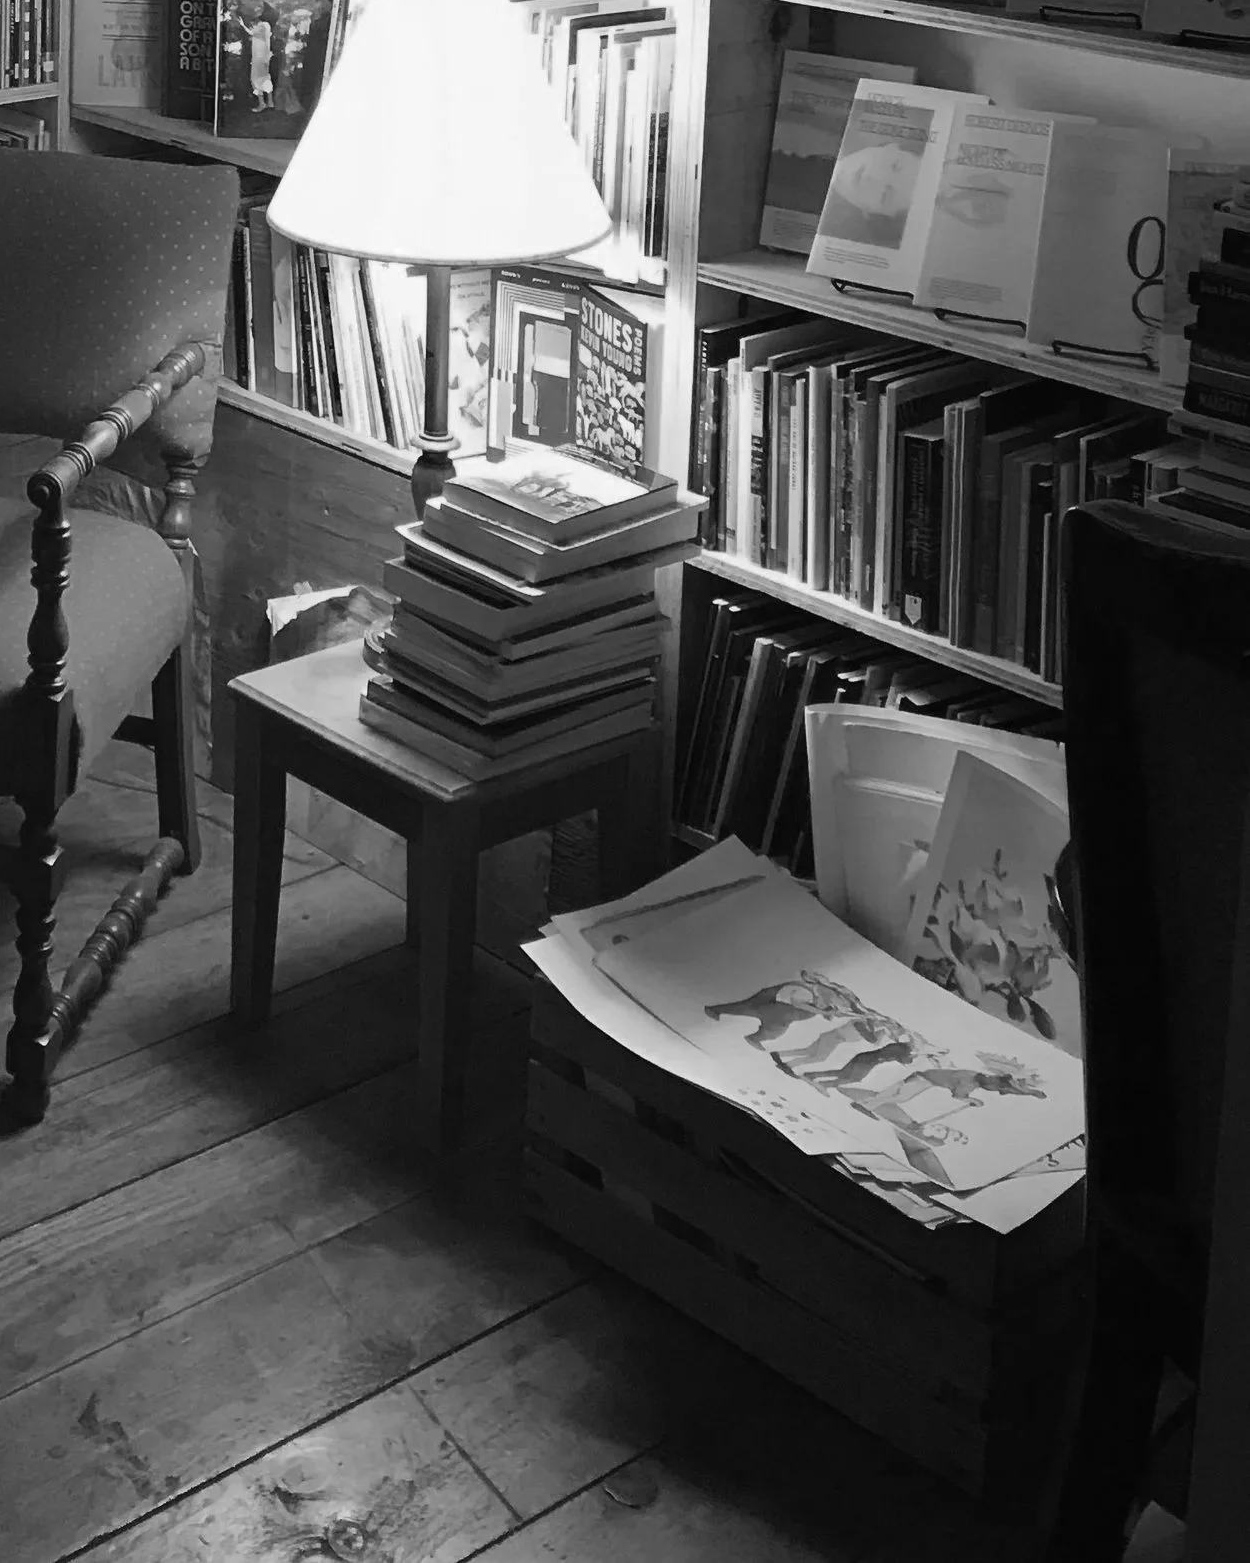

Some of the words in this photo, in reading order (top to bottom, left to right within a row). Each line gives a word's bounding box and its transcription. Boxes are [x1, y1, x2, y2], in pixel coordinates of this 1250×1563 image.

[180, 15, 217, 29] GRA
[580, 323, 600, 354] KEVIN
[602, 340, 633, 373] YOUNG
[581, 296, 633, 353] STONES
[633, 327, 643, 377] POEMS
